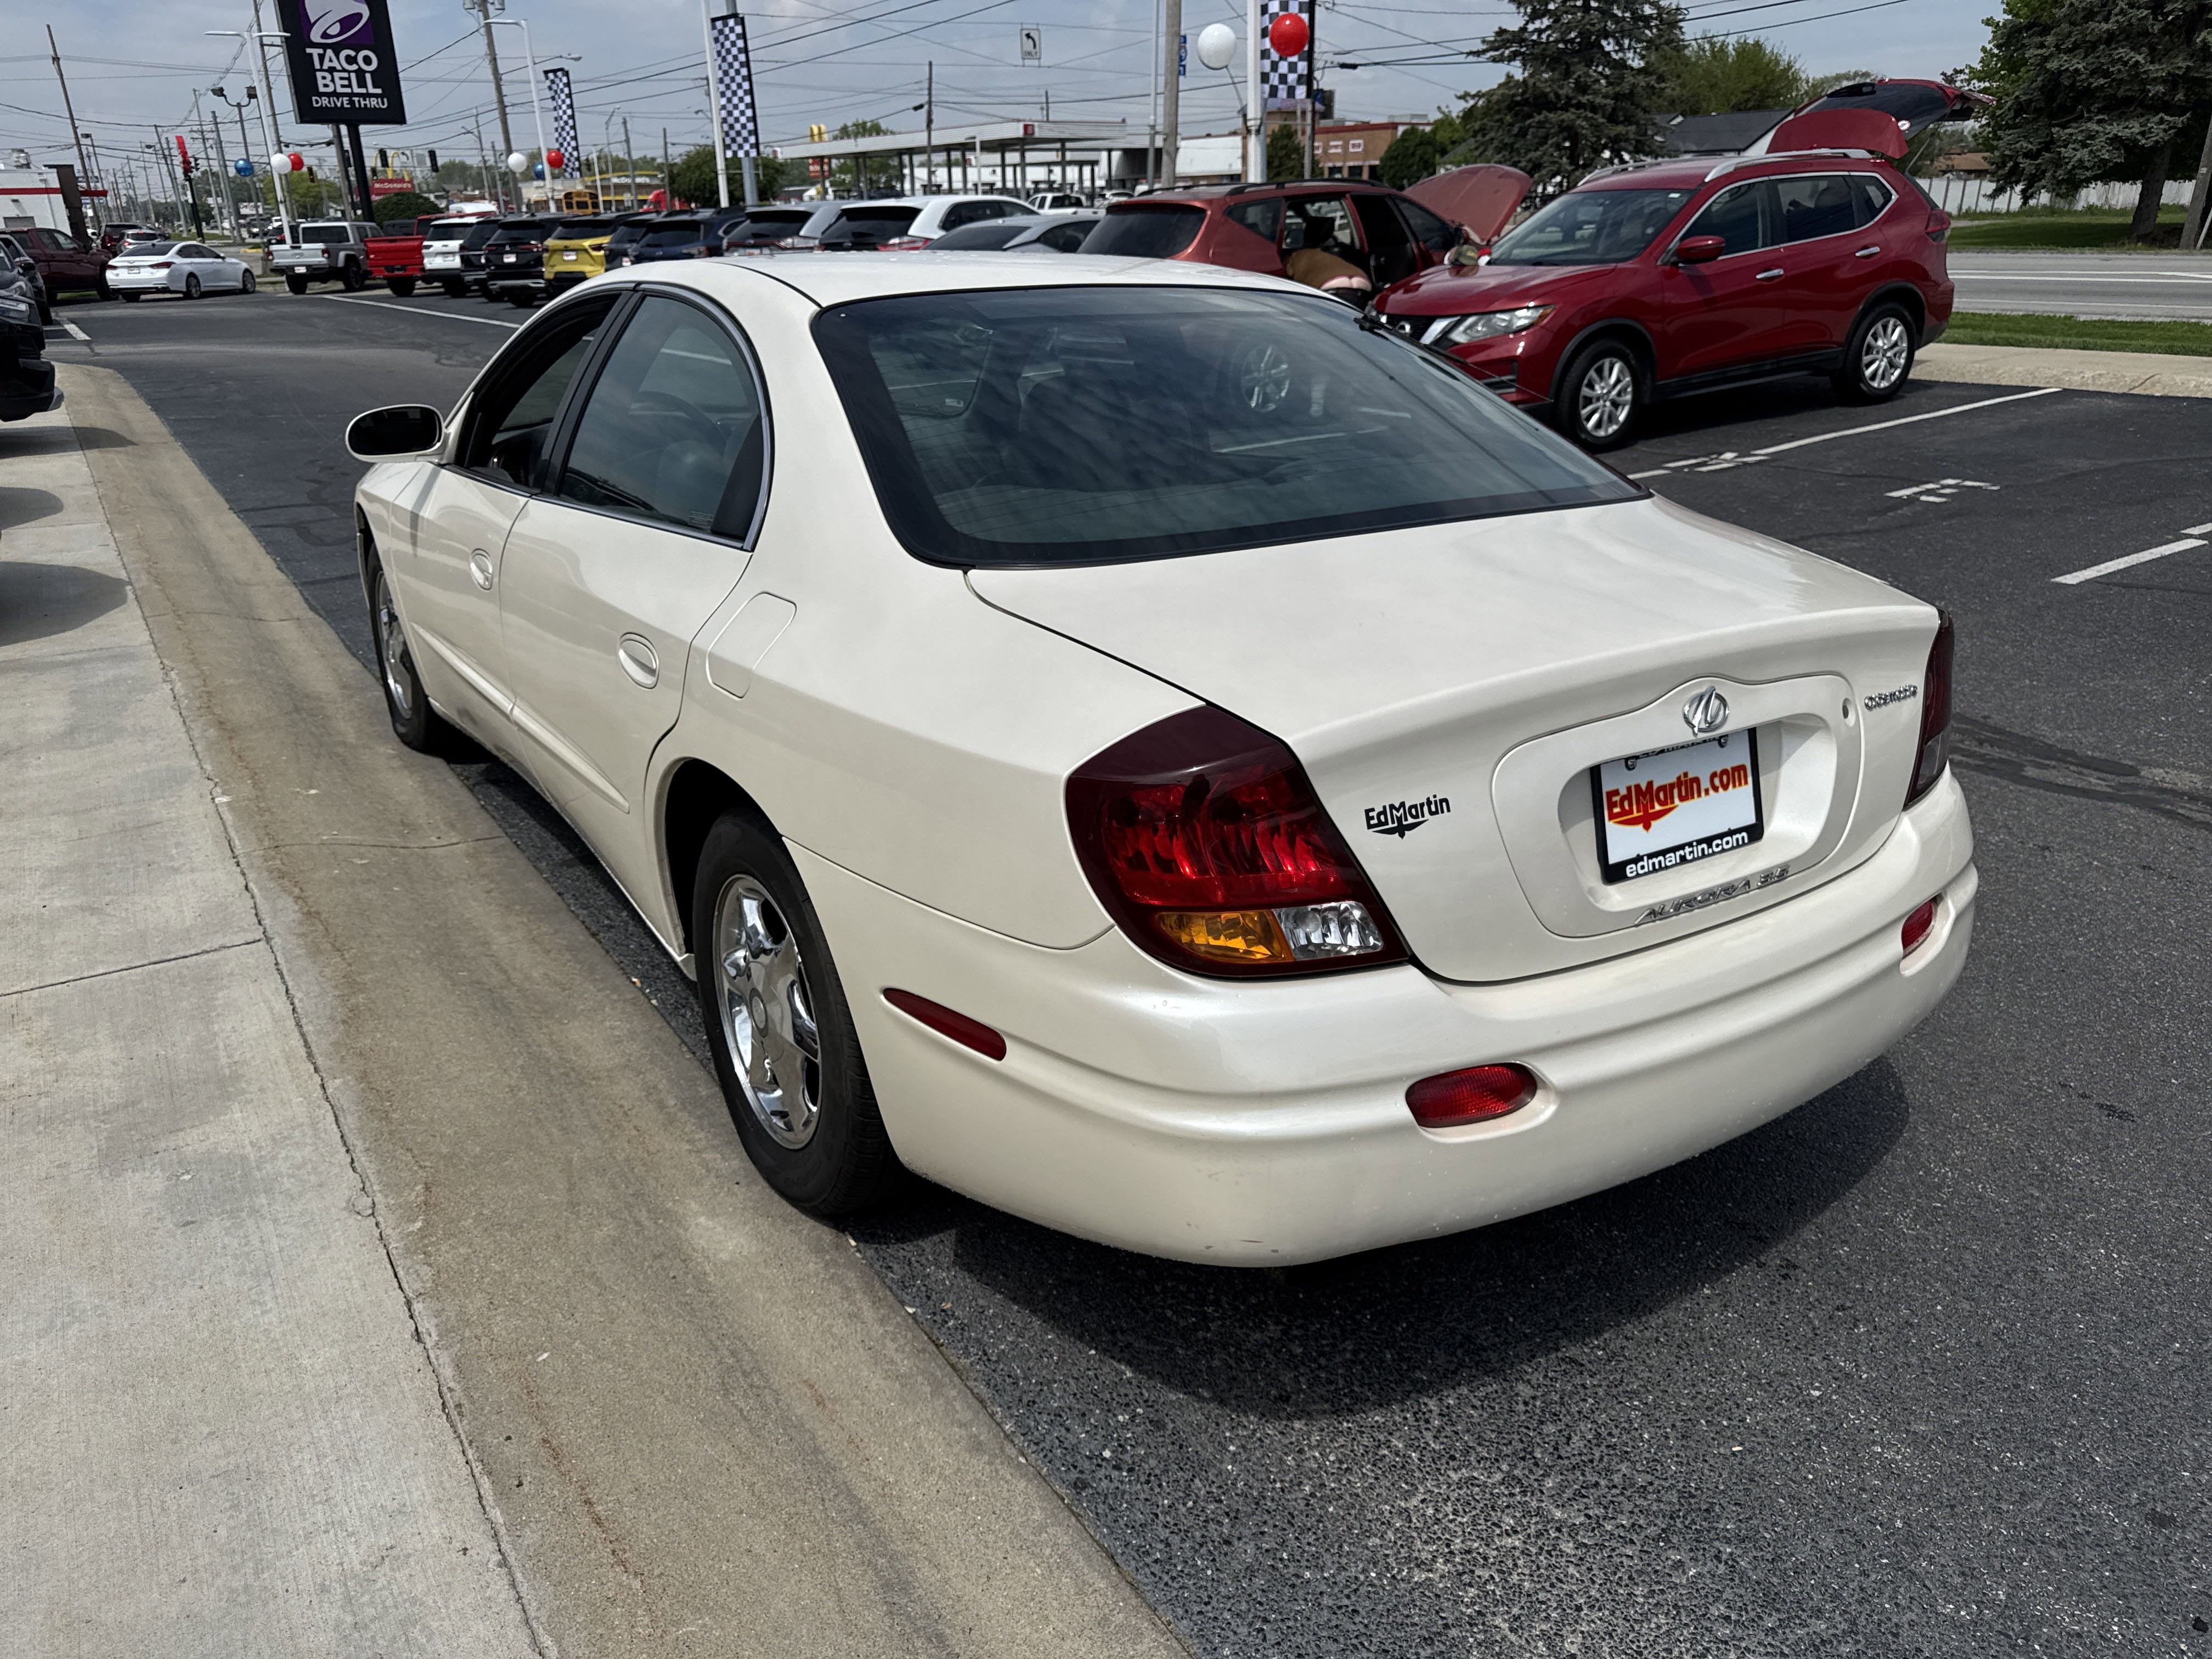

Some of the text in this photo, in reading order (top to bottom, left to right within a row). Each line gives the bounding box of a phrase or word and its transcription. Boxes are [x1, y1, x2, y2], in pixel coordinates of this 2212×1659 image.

[305, 48, 378, 71] TACO
[315, 71, 382, 94] BELL
[312, 96, 388, 109] DRIVE THRU
[1605, 763, 1749, 823] EdMartin.com
[1364, 794, 1451, 830] EdMartin
[1626, 831, 1748, 878] edmartin.com
[1634, 878, 1751, 924] AURORA
